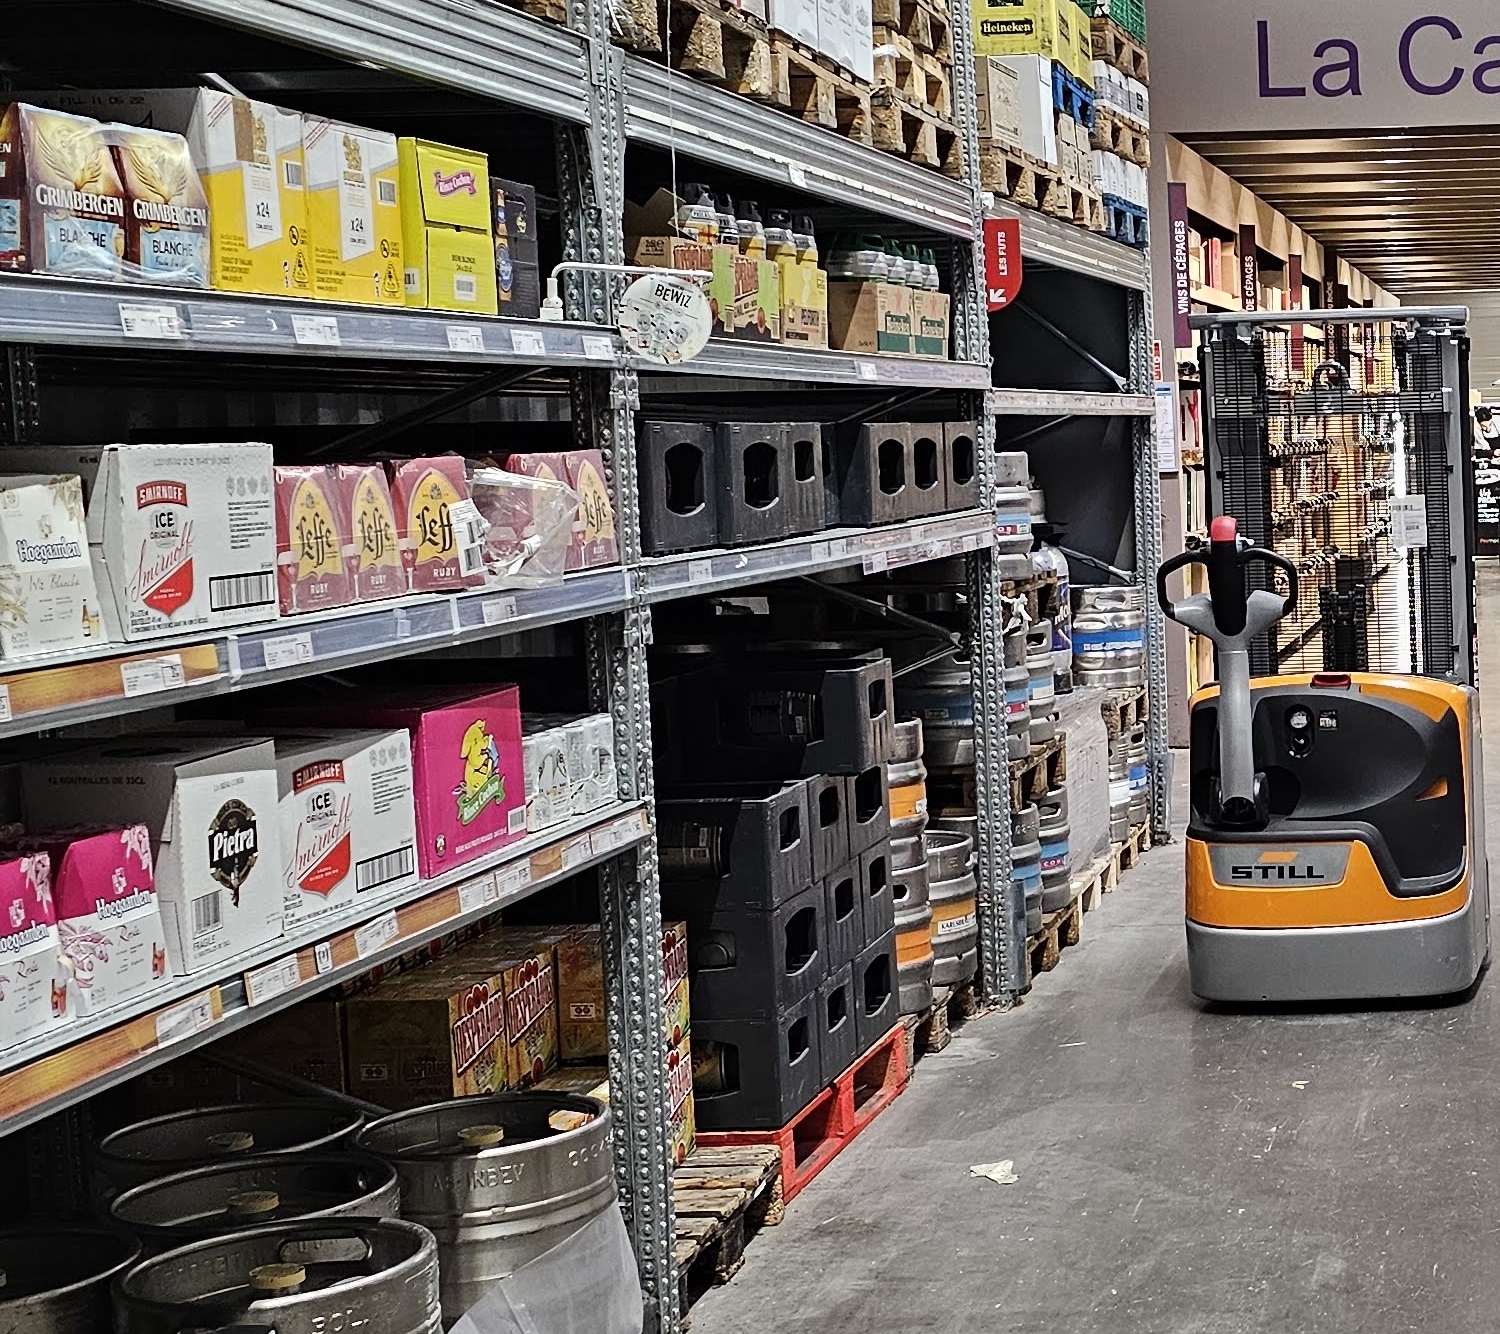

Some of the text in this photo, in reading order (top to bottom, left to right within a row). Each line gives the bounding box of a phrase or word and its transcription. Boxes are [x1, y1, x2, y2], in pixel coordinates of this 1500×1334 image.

[982, 21, 1032, 34] Heineken
[1256, 19, 1363, 98] La
[36, 184, 124, 217] GRIMBERGEN
[133, 198, 207, 227] GRIMBERGEN
[256, 202, 271, 218] x24
[152, 239, 194, 257] BLANCHE
[997, 231, 1009, 276] LES FUTS
[1174, 220, 1189, 314] VINS DE CÉPAGES
[655, 283, 692, 309] BEWIZ
[1243, 255, 1255, 311] DE CÉPAGES
[139, 485, 185, 505] SMIRNOFF
[155, 512, 175, 529] ICE
[582, 491, 607, 534] Leffe
[150, 530, 180, 540] ORIGINAL
[297, 512, 333, 569] Leffe
[358, 503, 392, 561] Leffe
[416, 501, 453, 553] Leff
[16, 536, 82, 564] Hoegaarden
[370, 574, 387, 586] RUBY
[433, 567, 457, 578] RUBY
[310, 583, 329, 595] RUBY
[296, 763, 342, 787] SMIRNOFF
[311, 792, 331, 812] ICE
[306, 810, 337, 824] ORIGINAL
[213, 826, 255, 863] Pietra
[1231, 865, 1325, 880] STILL
[96, 887, 152, 921] Hoegaarden
[0, 921, 49, 954] oegaarden
[193, 934, 216, 952] FRAGILE
[468, 1163, 526, 1191] INBEV
